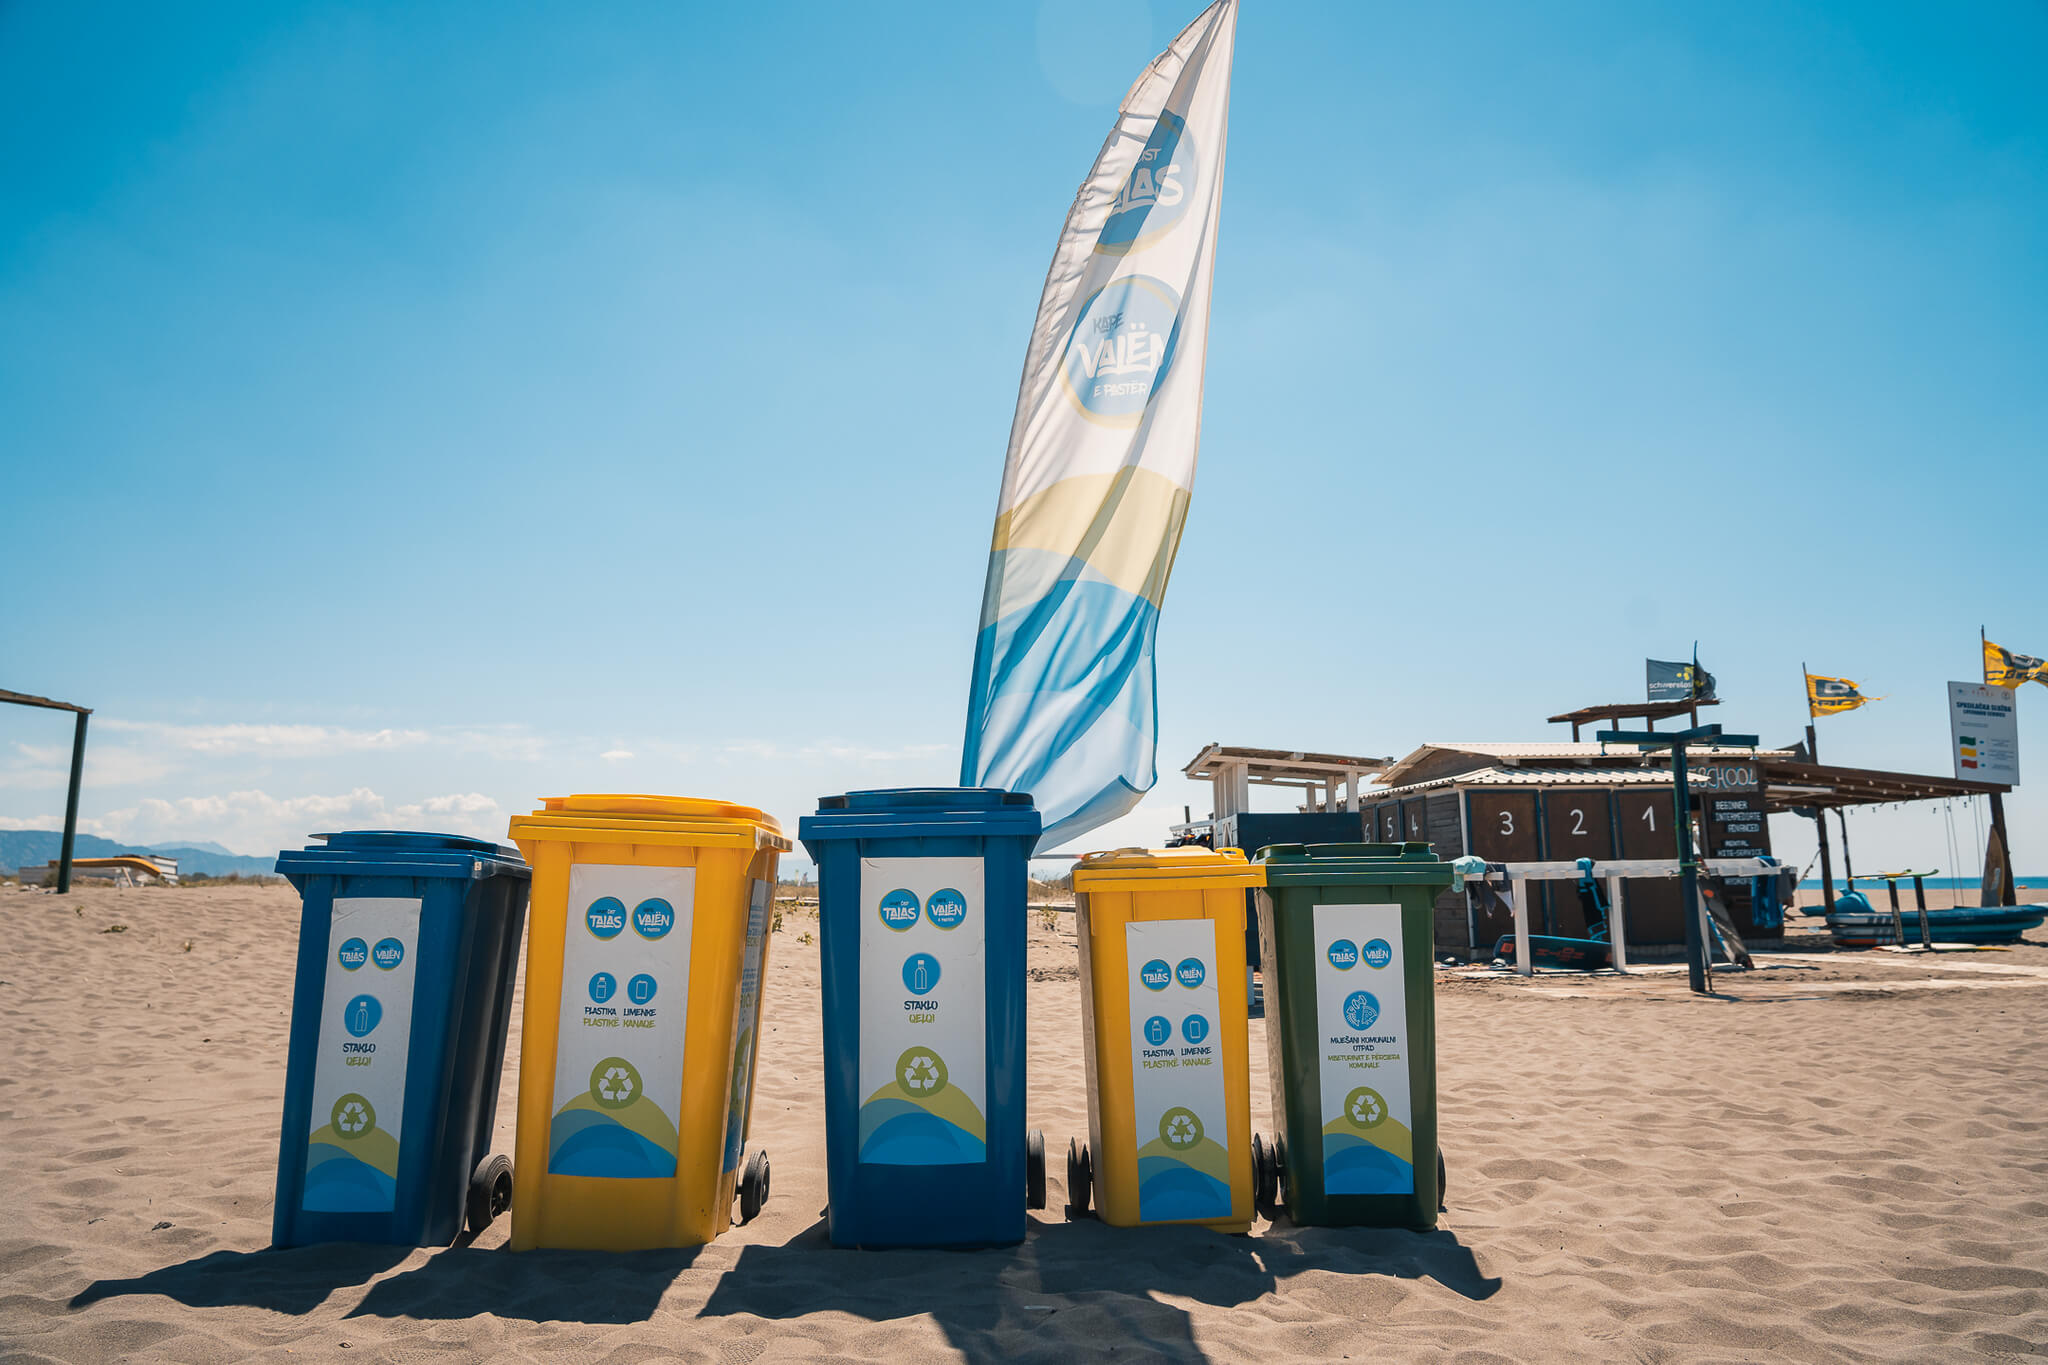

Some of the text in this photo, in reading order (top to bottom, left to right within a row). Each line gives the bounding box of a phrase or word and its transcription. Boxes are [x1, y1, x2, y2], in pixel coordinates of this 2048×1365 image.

[1093, 312, 1124, 335] KAPE
[1411, 813, 1419, 837] 4
[1499, 811, 1514, 836] 3
[1570, 809, 1587, 835] 2
[1641, 806, 1656, 832] 1
[1364, 823, 1371, 844] 6
[1386, 816, 1394, 838] 5
[883, 907, 916, 920] TALAS
[931, 900, 962, 916] VALËN
[589, 914, 622, 929] TALAS
[637, 911, 670, 927] VALËN
[341, 951, 365, 962] TALAS
[1330, 952, 1356, 963] TALAS
[1143, 972, 1169, 984] TALAS
[584, 1006, 657, 1017] PLASTIKA LIMENKE
[904, 1000, 939, 1010] STAKLO
[583, 1017, 620, 1028] PLASTIKË
[1361, 1036, 1396, 1044] KOMUNALNI
[342, 1042, 376, 1053] STAKLO
[1143, 1047, 1213, 1058] PLASTIKA LIMENKE
